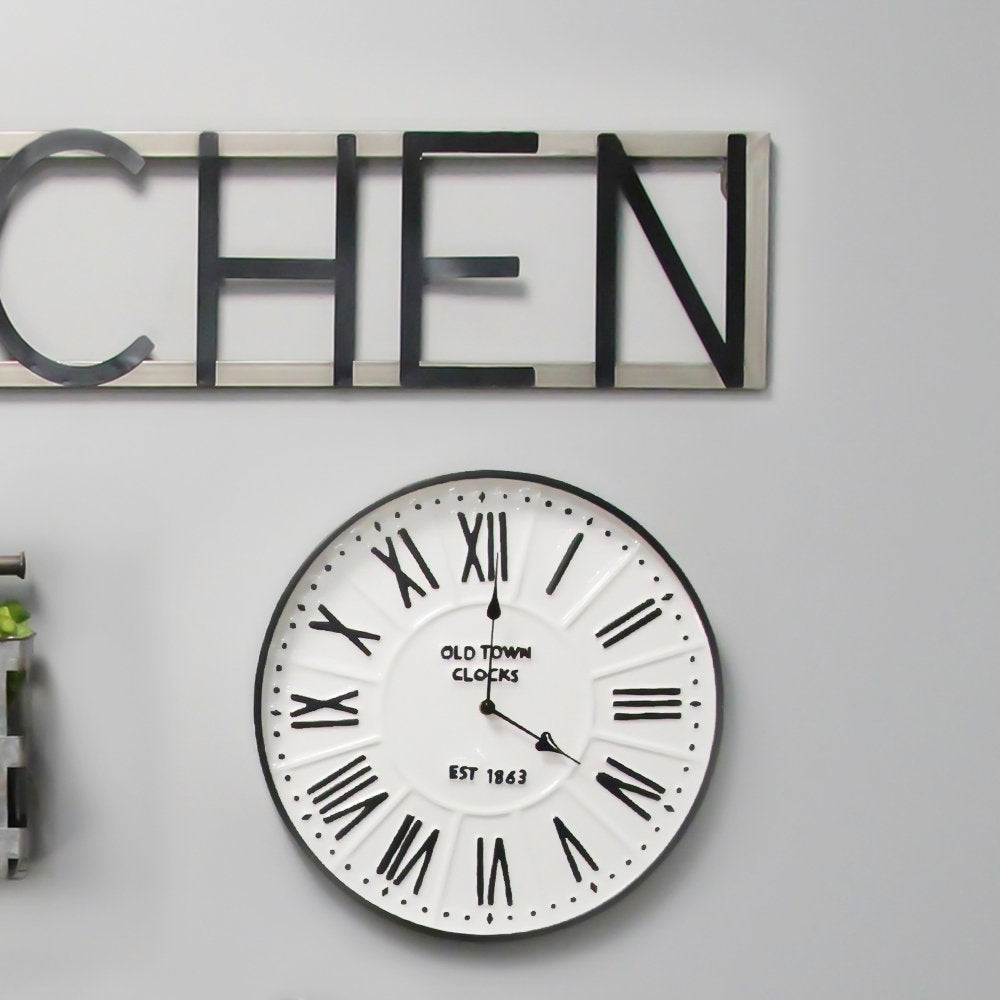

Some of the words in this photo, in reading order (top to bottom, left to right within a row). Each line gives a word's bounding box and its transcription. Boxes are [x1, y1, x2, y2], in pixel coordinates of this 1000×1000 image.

[370, 527, 440, 609] XI
[457, 511, 508, 583] XII
[545, 532, 584, 596] I
[308, 603, 381, 657] X
[440, 645, 476, 661] OLD
[480, 645, 532, 661] TOWN
[595, 598, 663, 649] II
[452, 667, 519, 683] CLOCKS
[612, 687, 683, 721] III
[289, 689, 360, 730] IX
[306, 754, 390, 841] VIII
[448, 764, 479, 781] EST
[486, 768, 528, 785] 1863
[595, 756, 666, 822] IV
[376, 814, 440, 896] VII
[476, 837, 513, 907] VI
[552, 816, 600, 883] V
